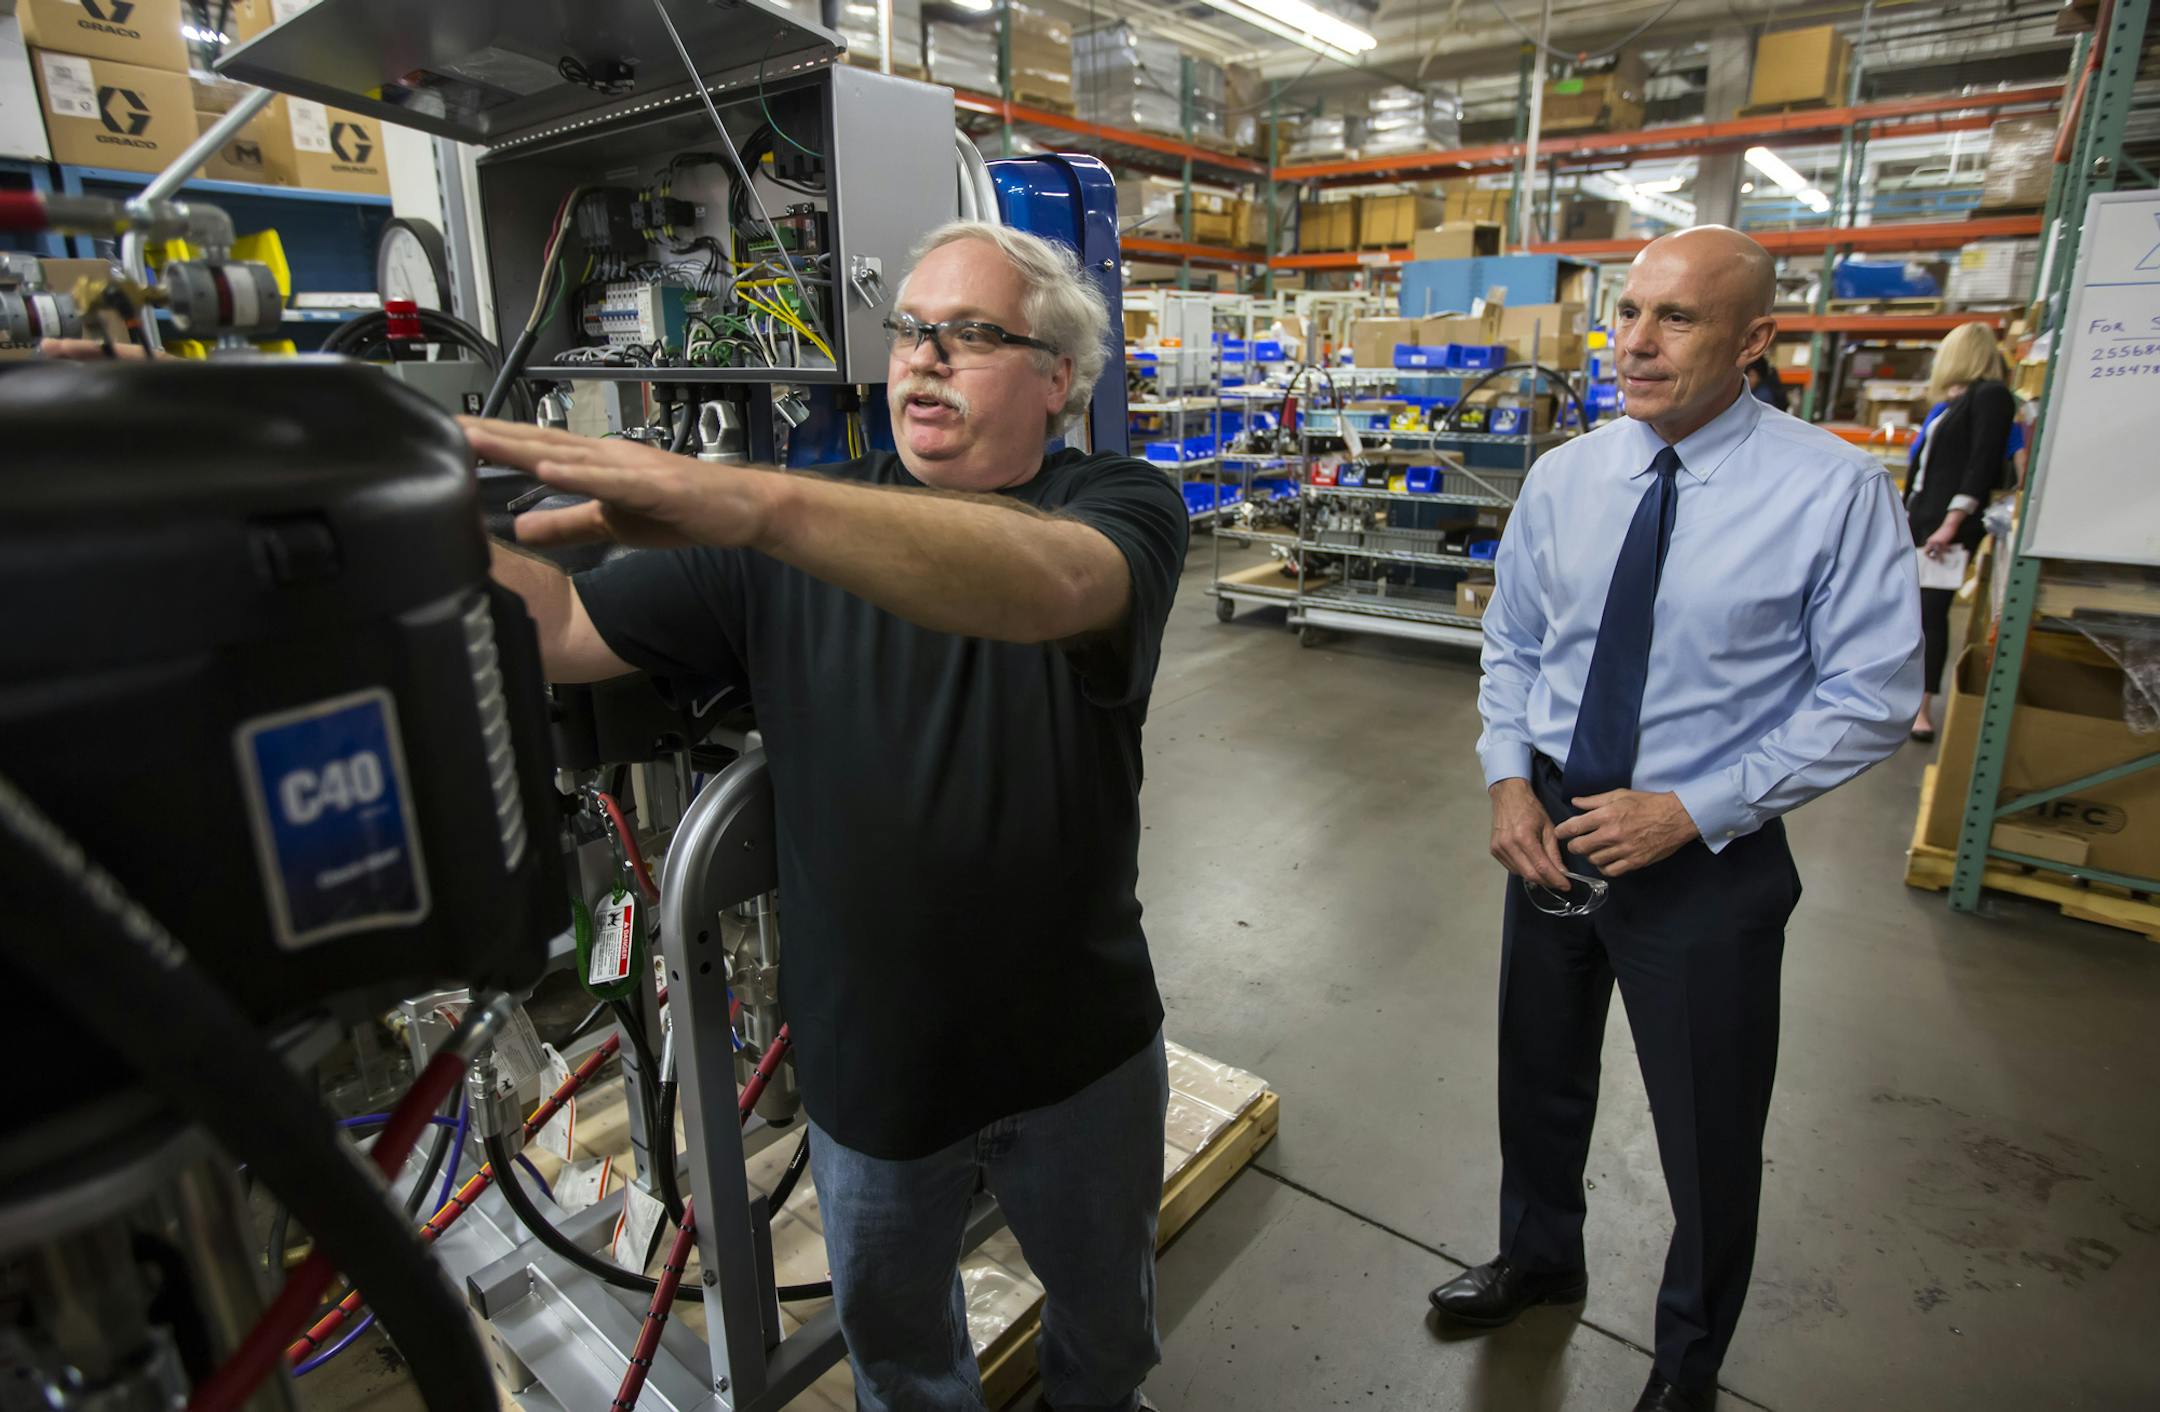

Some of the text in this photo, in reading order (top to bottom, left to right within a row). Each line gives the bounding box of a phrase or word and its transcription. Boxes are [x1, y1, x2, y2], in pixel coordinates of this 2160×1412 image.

[78, 20, 140, 39] GRACO
[96, 135, 158, 149] GRACO
[280, 750, 385, 826] C40
[621, 929, 630, 960] DANGER
